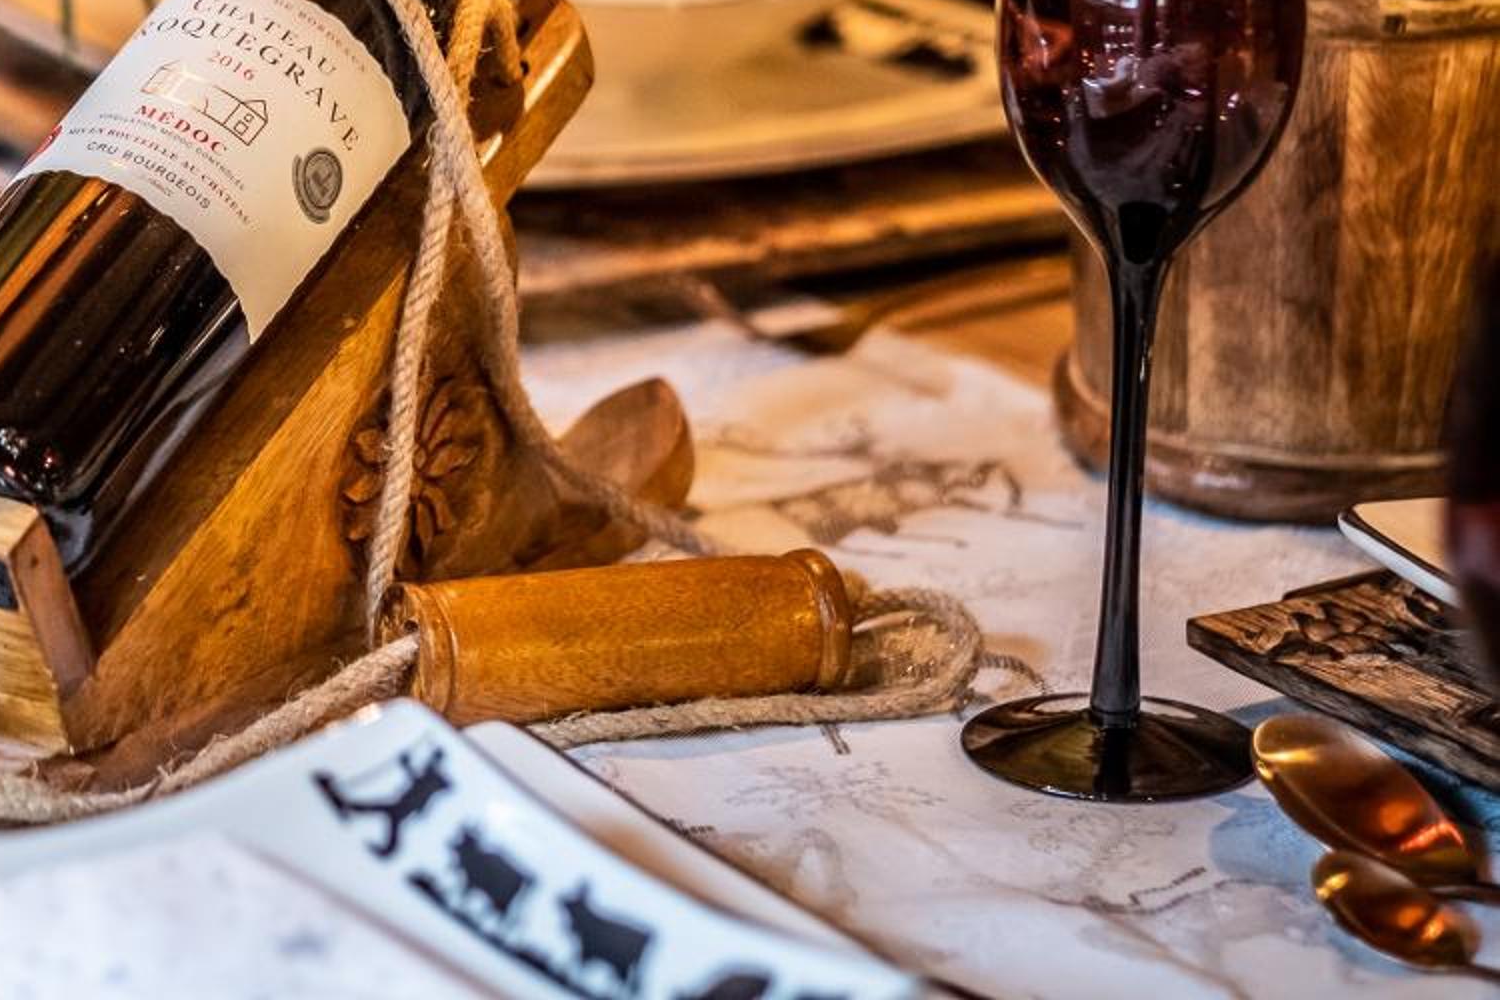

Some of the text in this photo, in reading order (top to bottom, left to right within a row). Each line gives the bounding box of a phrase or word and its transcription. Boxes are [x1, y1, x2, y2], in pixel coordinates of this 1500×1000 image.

[208, 51, 257, 82] 2016
[135, 104, 228, 156] MÉDOC
[87, 141, 119, 155] CRU
[122, 150, 211, 209] BOURGEOIS
